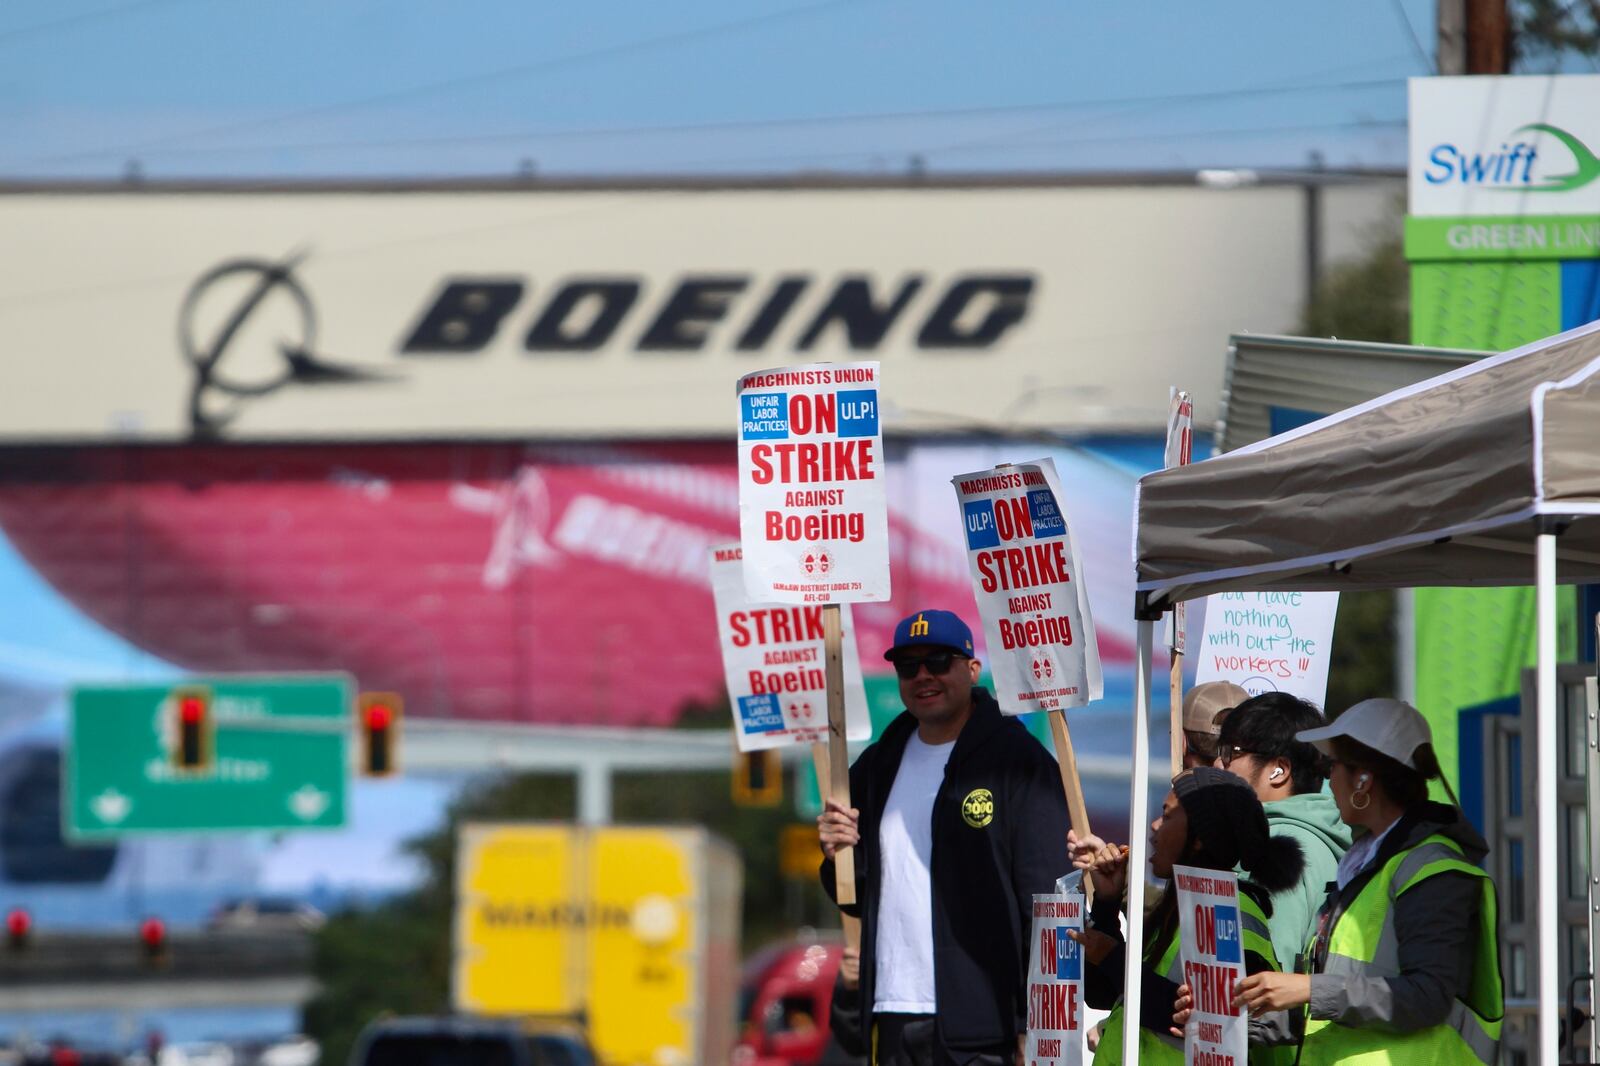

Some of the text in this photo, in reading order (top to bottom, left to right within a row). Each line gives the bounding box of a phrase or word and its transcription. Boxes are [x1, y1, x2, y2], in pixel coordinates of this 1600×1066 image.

[1424, 142, 1536, 184] Swift
[1446, 223, 1546, 250] GREEN
[398, 271, 1037, 352] BOEING
[743, 368, 874, 388] MACHINISTS UNION
[751, 396, 779, 407] UNFAIR
[752, 408, 778, 419] LABOR
[841, 401, 875, 420] ULP!
[743, 420, 788, 432] PRACTICES!
[789, 393, 836, 436] ON
[751, 440, 875, 485] STRIKE
[960, 474, 1022, 495] MACHINISTS
[785, 489, 844, 507] AGAINST
[1036, 504, 1056, 516] LABOR
[766, 510, 864, 542] Boeing
[967, 511, 994, 532] ULP!
[994, 496, 1034, 542] ON
[977, 541, 1070, 594] STRIKE
[800, 583, 830, 592] DISTRICT
[831, 582, 850, 591] LODGE
[851, 582, 862, 590] 751
[804, 593, 831, 602] AFL-CIO
[1008, 593, 1052, 614] AGAINST
[729, 606, 843, 647] STRIK
[999, 614, 1073, 650] Boeing
[1224, 608, 1292, 640] nothing
[1208, 629, 1315, 656] with out the
[764, 647, 818, 665] AGAINST
[1215, 654, 1292, 678] workers
[748, 666, 825, 696] Boein
[1213, 879, 1236, 897] UNION
[1055, 902, 1080, 918] UNION
[1195, 904, 1216, 955] ON
[1216, 919, 1238, 941] ULP!
[1041, 928, 1057, 975] ON
[1058, 939, 1078, 959] ULP!
[1185, 960, 1240, 1017] STRIKE
[1029, 984, 1078, 1031] STRIKE
[1199, 1020, 1223, 1044] AGAINST
[1037, 1039, 1062, 1057] AGAINST
